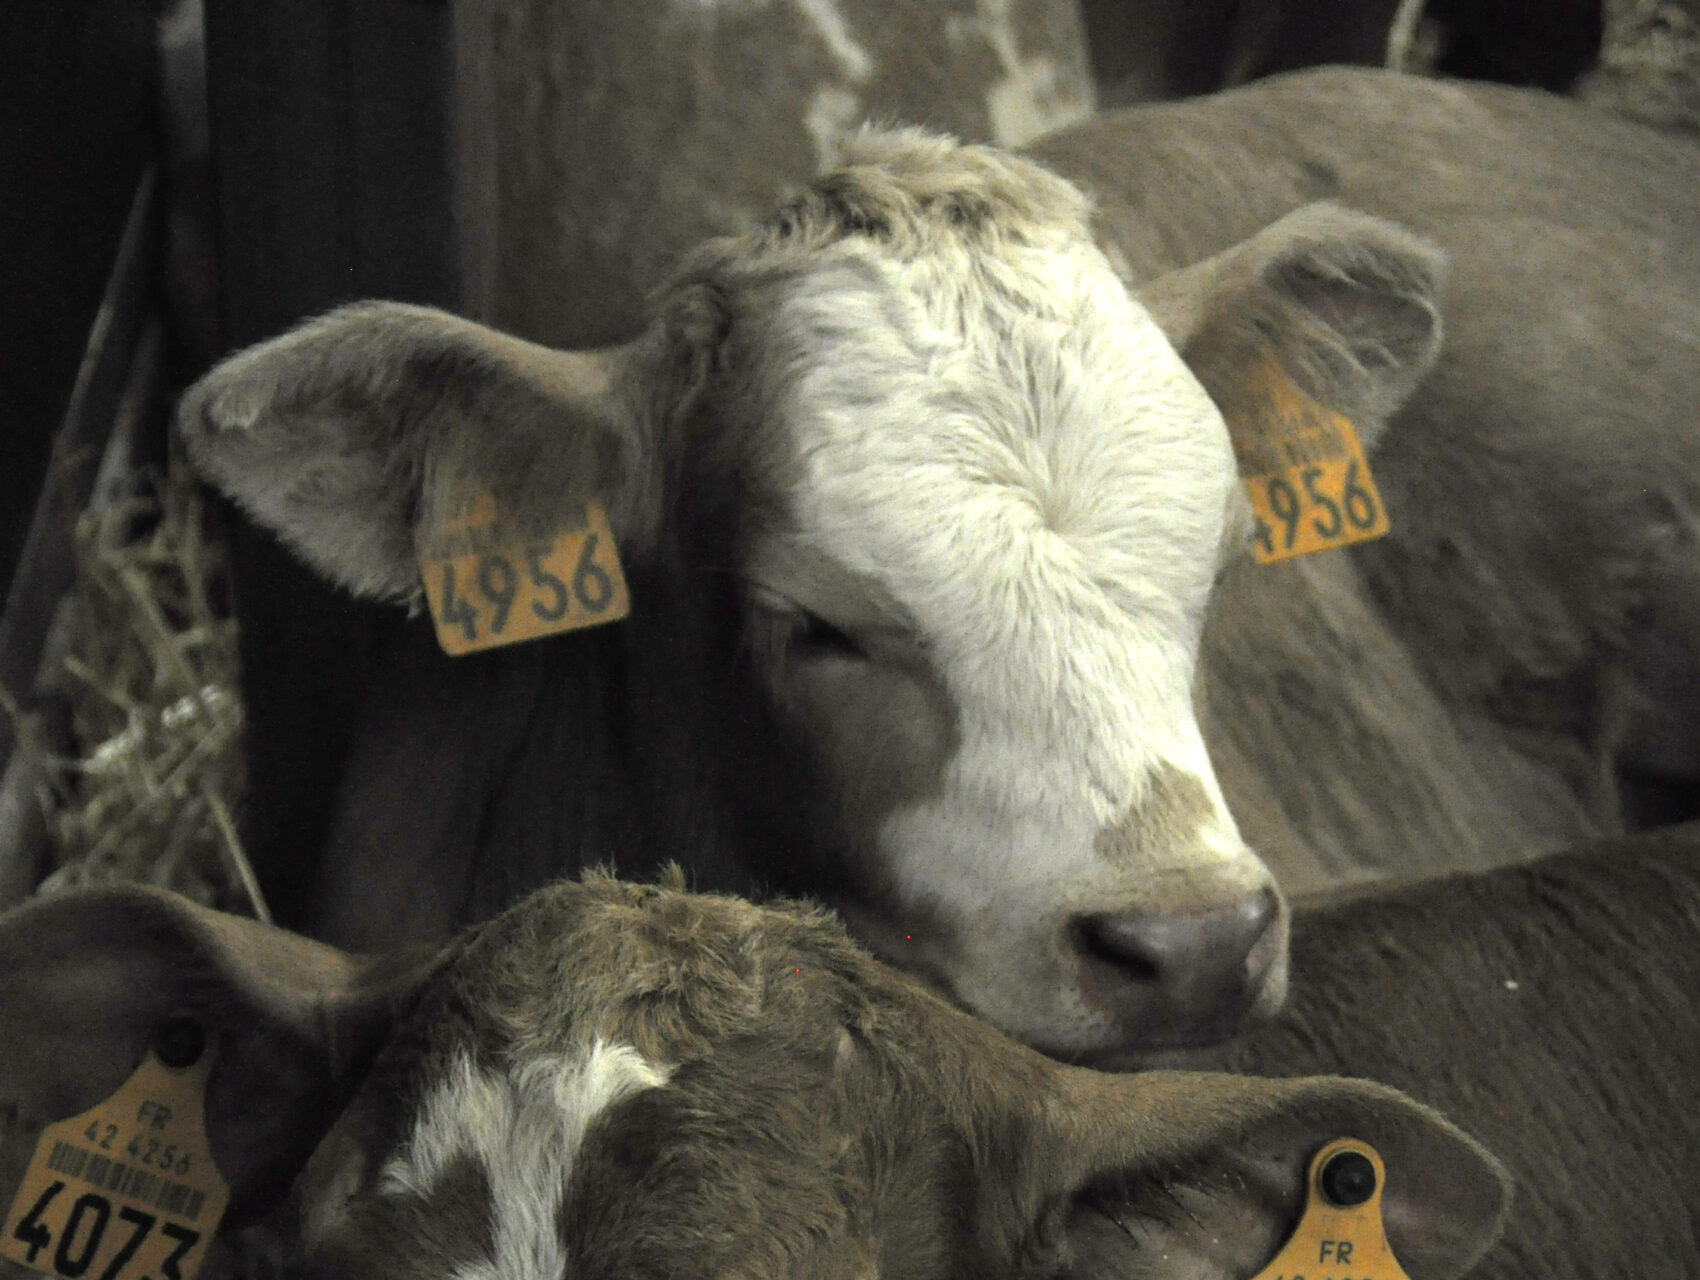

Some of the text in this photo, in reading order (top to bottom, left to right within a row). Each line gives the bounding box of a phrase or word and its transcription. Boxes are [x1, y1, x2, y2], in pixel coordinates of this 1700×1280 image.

[441, 533, 613, 641] 4956
[136, 1100, 173, 1131] FR
[84, 1120, 118, 1149] 42
[1319, 1240, 1354, 1265] FR
